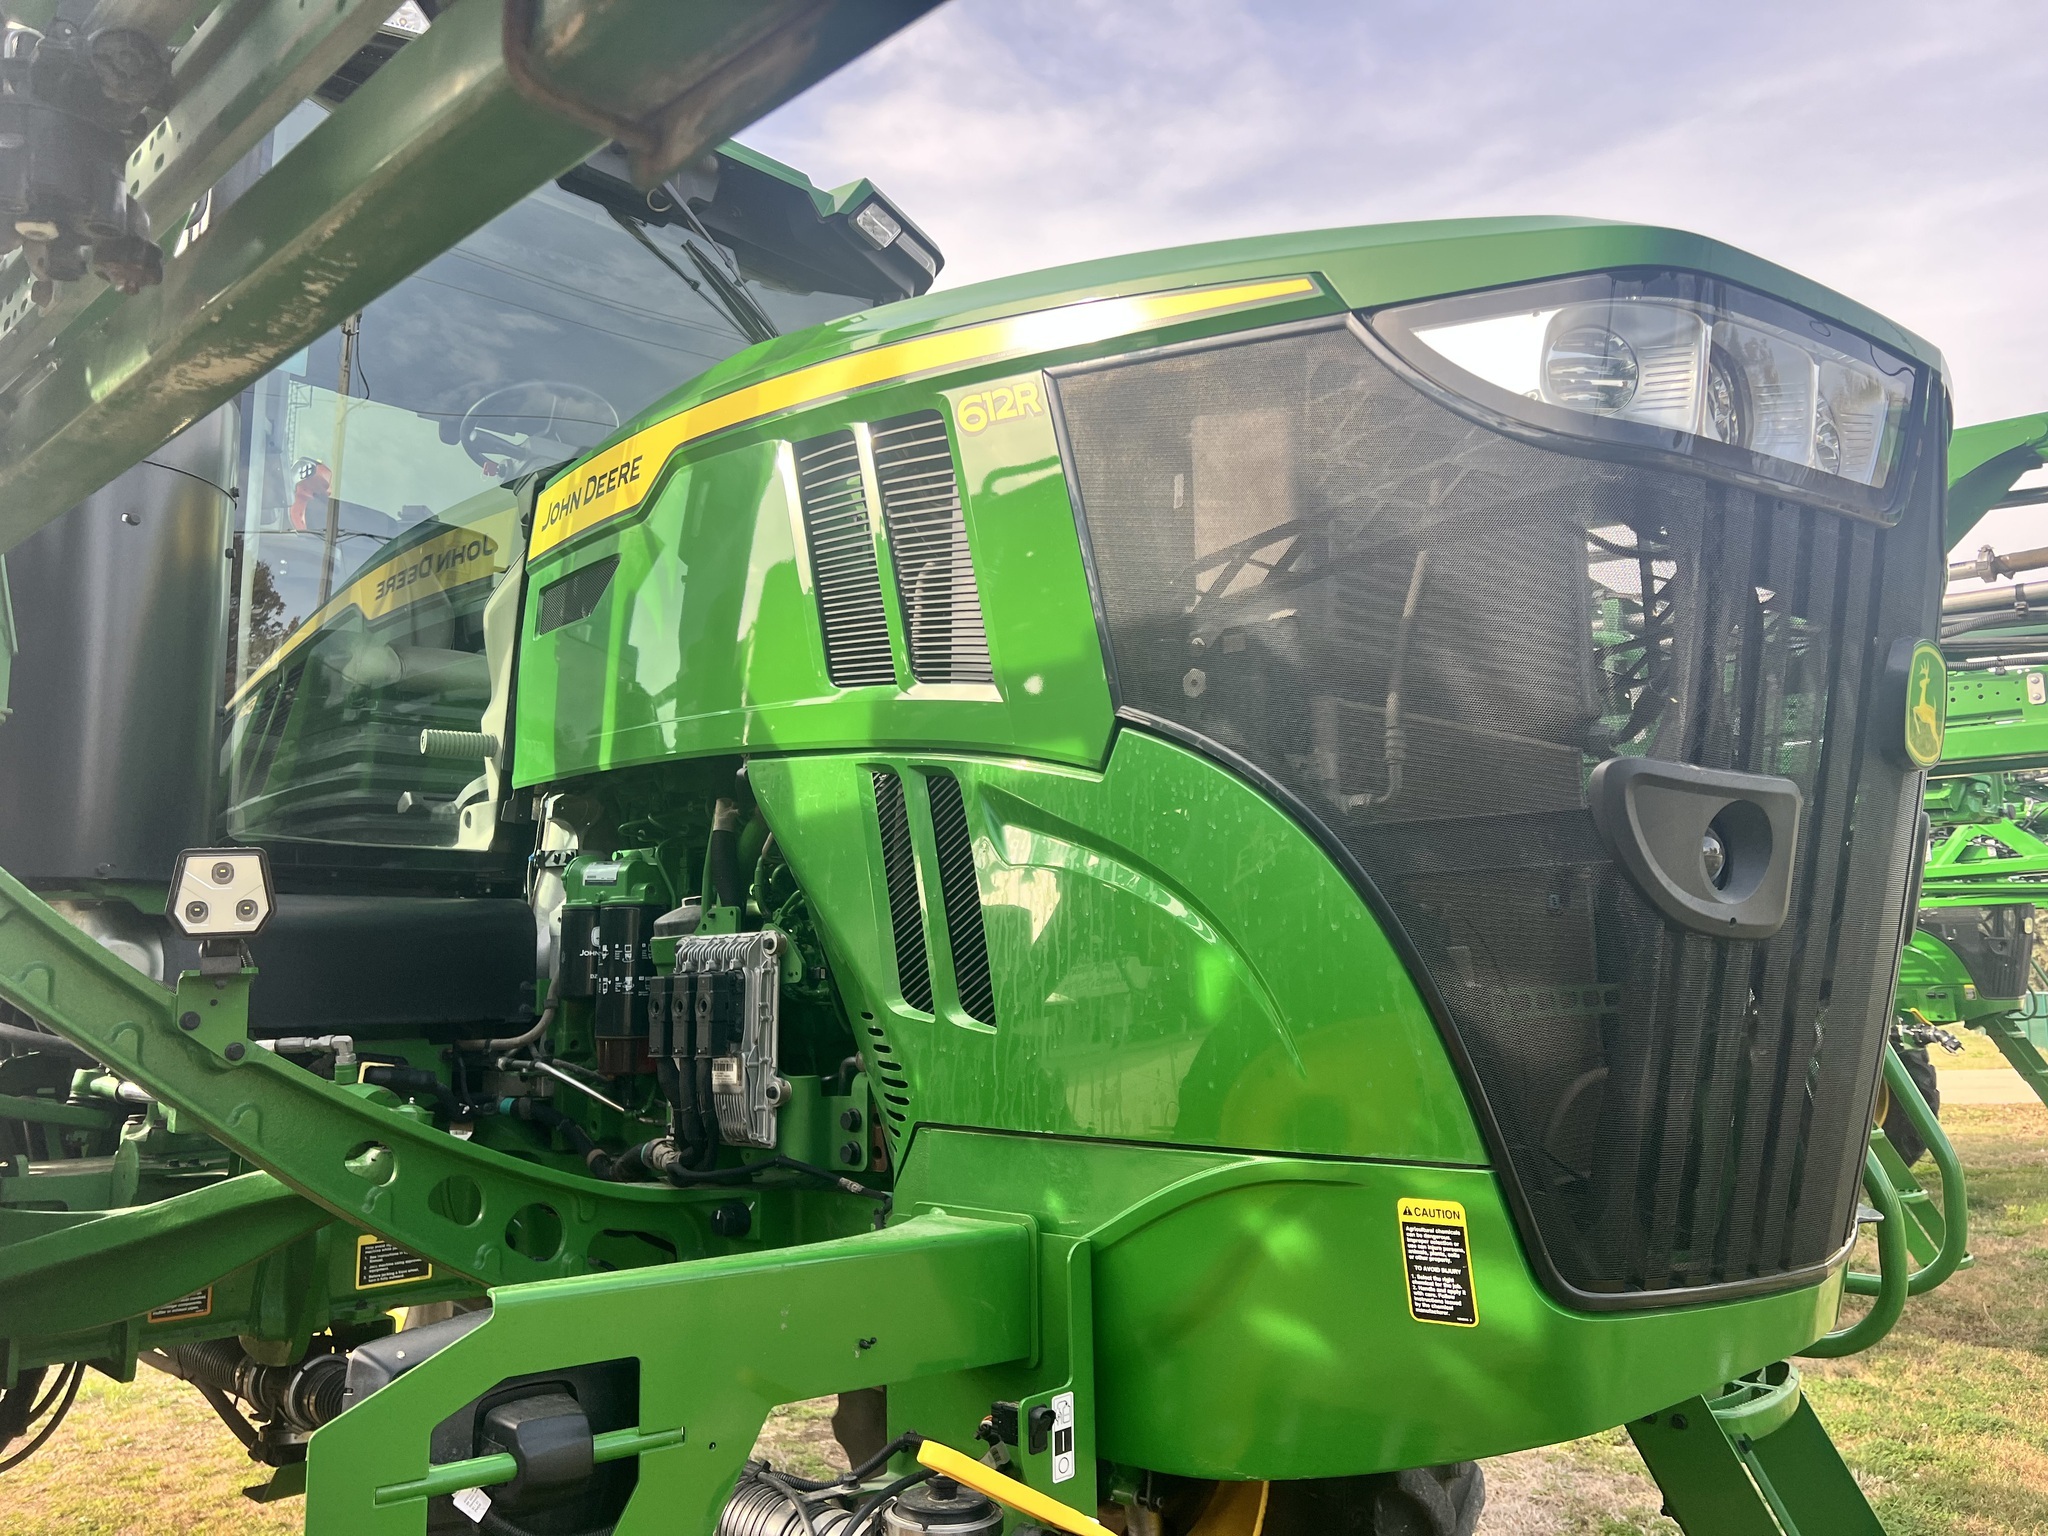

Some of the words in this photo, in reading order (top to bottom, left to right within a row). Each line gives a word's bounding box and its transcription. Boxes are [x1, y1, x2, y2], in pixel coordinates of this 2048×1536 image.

[956, 382, 1043, 434] 612R
[541, 487, 582, 532] JOHN
[583, 454, 643, 506] DEERE
[1414, 1207, 1460, 1220] CAUTION
